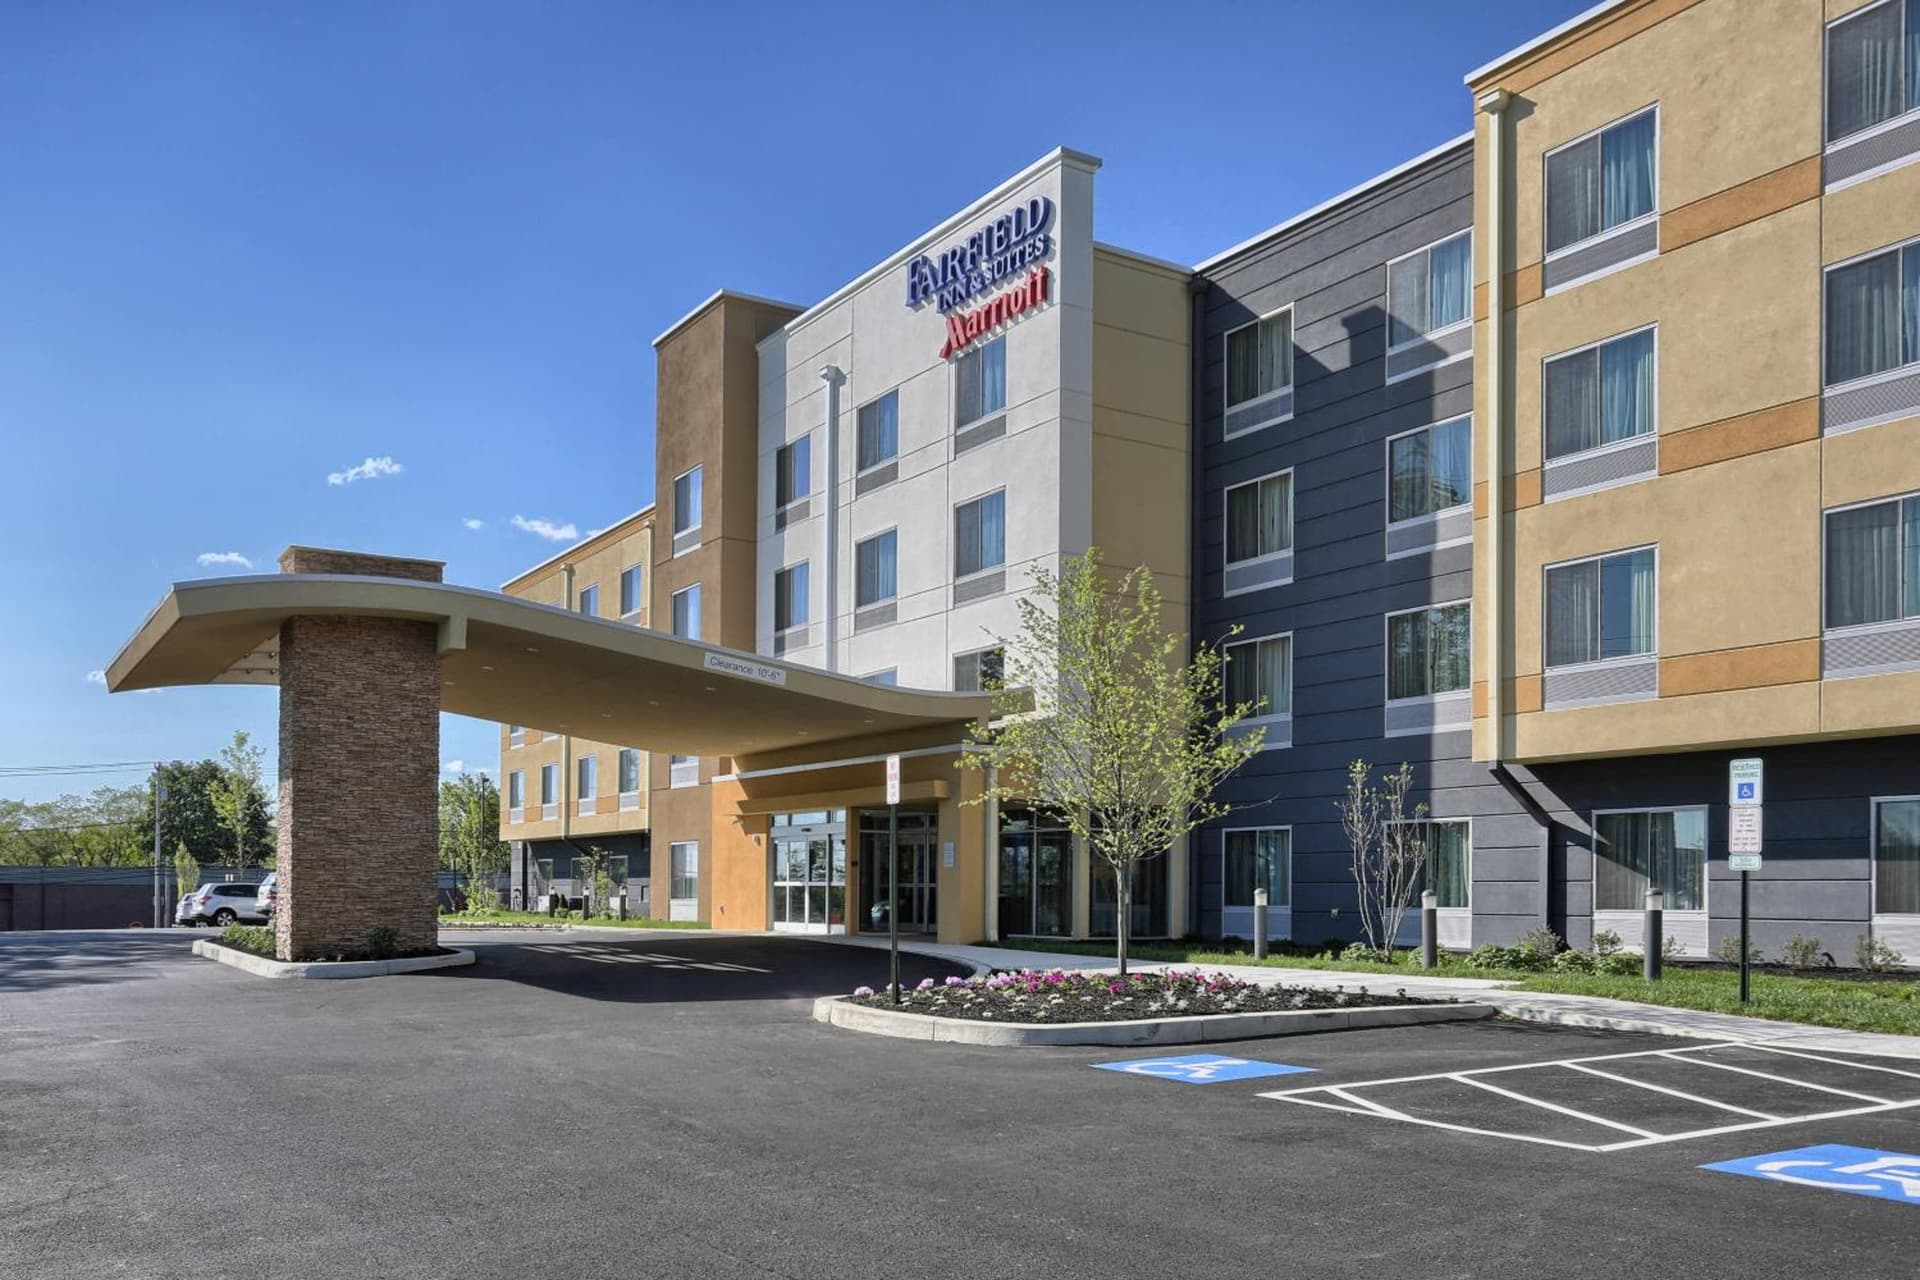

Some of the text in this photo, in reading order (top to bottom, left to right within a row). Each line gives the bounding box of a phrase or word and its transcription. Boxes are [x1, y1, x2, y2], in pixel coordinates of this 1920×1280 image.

[906, 194, 1051, 306] FAIRFIELD
[936, 233, 1046, 314] INN & SUITES
[940, 264, 1049, 360] Marriott
[710, 655, 754, 675] Clearance
